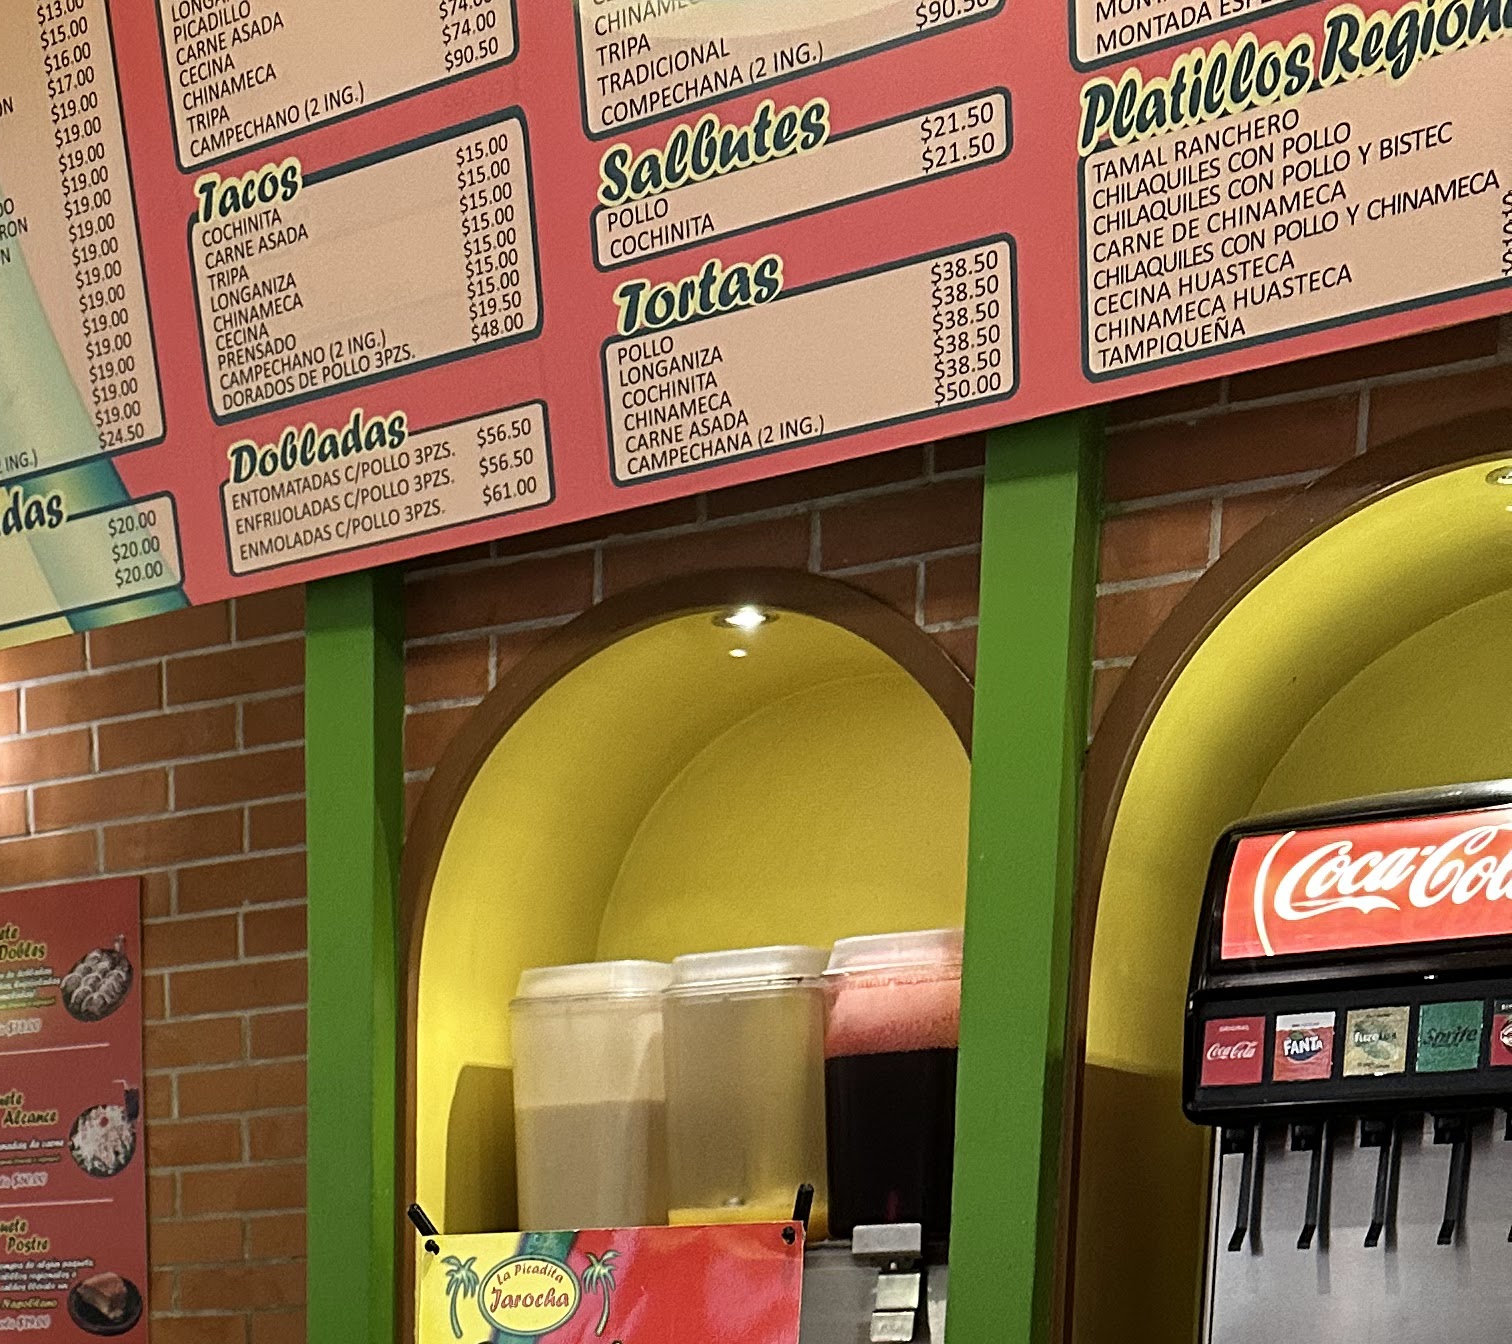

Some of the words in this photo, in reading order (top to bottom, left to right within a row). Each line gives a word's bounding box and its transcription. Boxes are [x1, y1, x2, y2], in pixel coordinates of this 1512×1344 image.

[1096, 1, 1212, 54] MONTADA
[1081, 41, 1310, 148] Platillos
[1321, 0, 1512, 80] Region
[603, 103, 825, 199] Salbutes
[608, 198, 668, 232] POLLO
[921, 102, 993, 144] $21.50
[1092, 147, 1167, 183] TAMAL
[1175, 110, 1299, 162] RANCHERO
[1093, 157, 1220, 209] CHILAQUILES
[1228, 142, 1273, 173] CON
[1283, 122, 1351, 159] POLLO
[1094, 184, 1220, 236] CHILAQUILES
[1228, 169, 1273, 200] CON
[1283, 150, 1350, 186] POLLO
[1358, 143, 1372, 165] Y
[1380, 122, 1452, 160] BISTEC
[198, 165, 298, 221] Tacos
[202, 208, 282, 247] COCHINITA
[456, 134, 508, 168] $15.00
[610, 213, 714, 259] COCHINITA
[922, 132, 994, 173] $21.50
[1095, 227, 1164, 263] CARNE
[1173, 218, 1199, 243] DE
[1207, 180, 1346, 233] CHINAMECA
[618, 336, 673, 365] POLLO
[931, 250, 998, 286] $38.50
[619, 257, 780, 331] Tortas
[1097, 281, 1171, 316] CECINA
[1179, 250, 1294, 297] HUASTECA
[1098, 295, 1226, 343] CHINAMECA
[1234, 264, 1352, 310] HUASTECA
[223, 376, 295, 410] DORADOS
[298, 369, 318, 389] DE
[322, 355, 370, 383] POLLO
[375, 344, 415, 368] 3PZS.
[472, 312, 523, 343] $48.00
[620, 346, 723, 387] LONGANIZA
[932, 274, 998, 310] $38.50
[1098, 315, 1245, 368] TAMPIQUEÑA
[624, 391, 732, 431] CHINAMECA
[934, 324, 1000, 359] $38.50
[232, 414, 406, 481] Dobladas
[232, 469, 341, 510] ENTOMATADAS
[345, 442, 410, 483] C/POLLO
[414, 441, 455, 465] 3PZS.
[477, 418, 531, 449] $56.50
[112, 536, 160, 564] $20.00
[1426, 1025, 1478, 1047] Sprite
[3, 1110, 58, 1128] Alcance
[7, 1235, 50, 1254] Postre
[496, 1270, 511, 1285] La
[514, 1263, 564, 1284] Picadita
[490, 1286, 569, 1314] Jarocha
